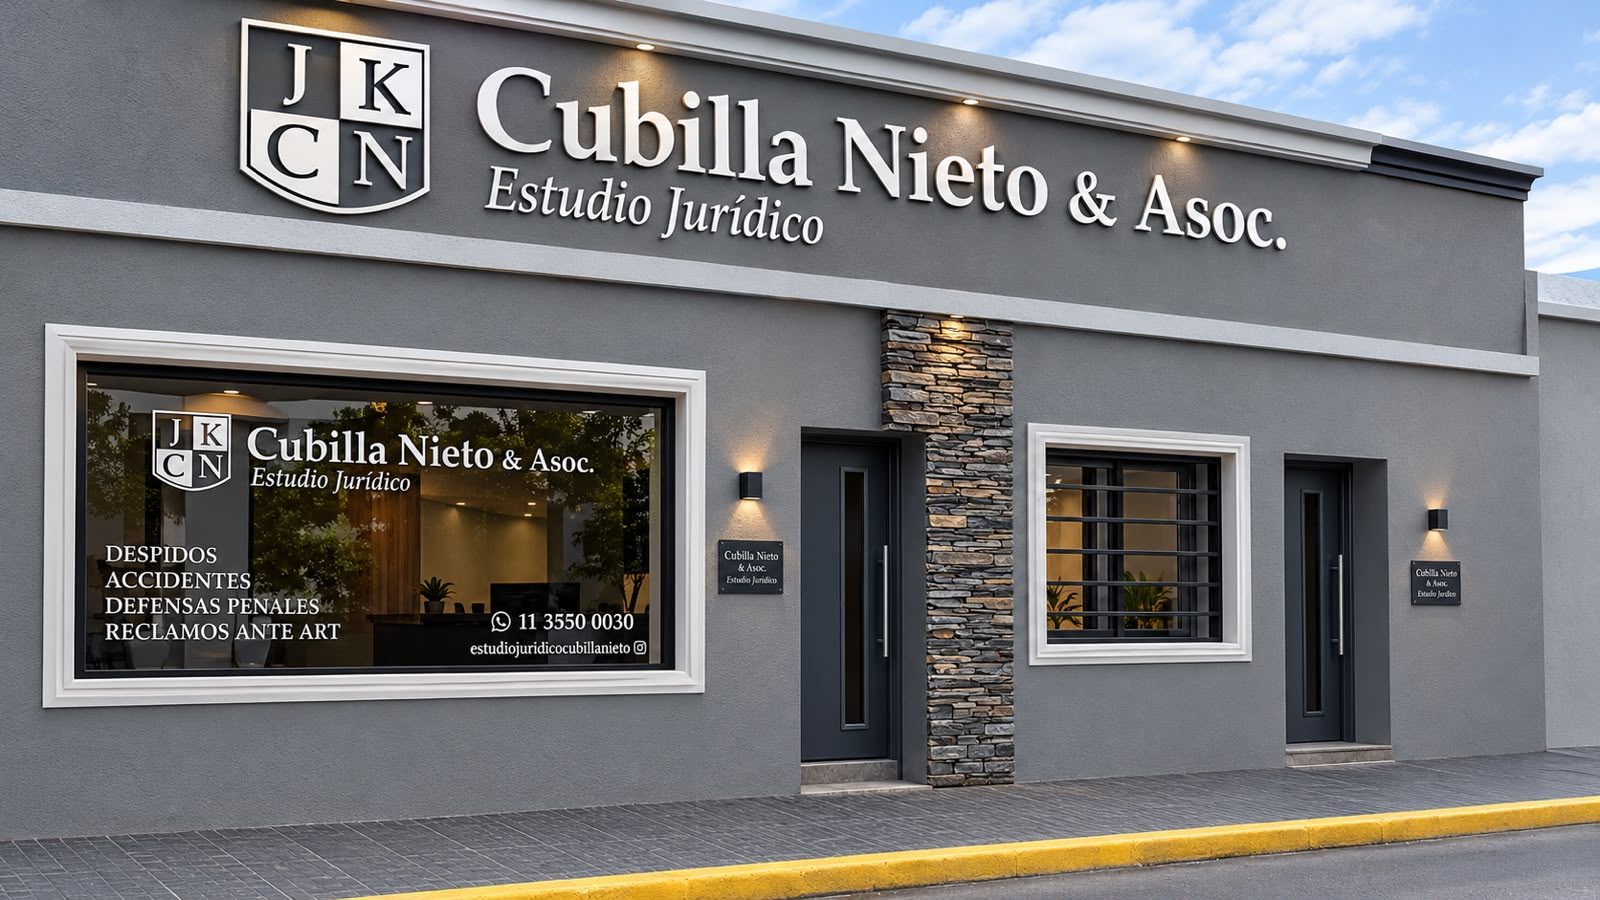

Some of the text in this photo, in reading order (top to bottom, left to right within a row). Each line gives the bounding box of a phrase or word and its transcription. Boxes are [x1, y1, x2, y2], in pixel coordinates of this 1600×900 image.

[476, 66, 1288, 251] Cubilla Nieto & Asoc.
[485, 165, 825, 246] Estudio Jurídico
[247, 427, 595, 474] Cubilla Nieto & Asoc.
[251, 467, 411, 494] Estudio Jurídico
[105, 545, 217, 564] DESPIDOS
[724, 551, 779, 561] Cubilla Nieto
[105, 571, 252, 590] ACCIDENTES
[105, 597, 320, 616] DEFENSAS PENALES
[518, 613, 634, 630] 11 3550 0030
[105, 623, 341, 641] RECLAMOS ANTE ART
[470, 641, 631, 658] estudiojuridicocubillanieto
